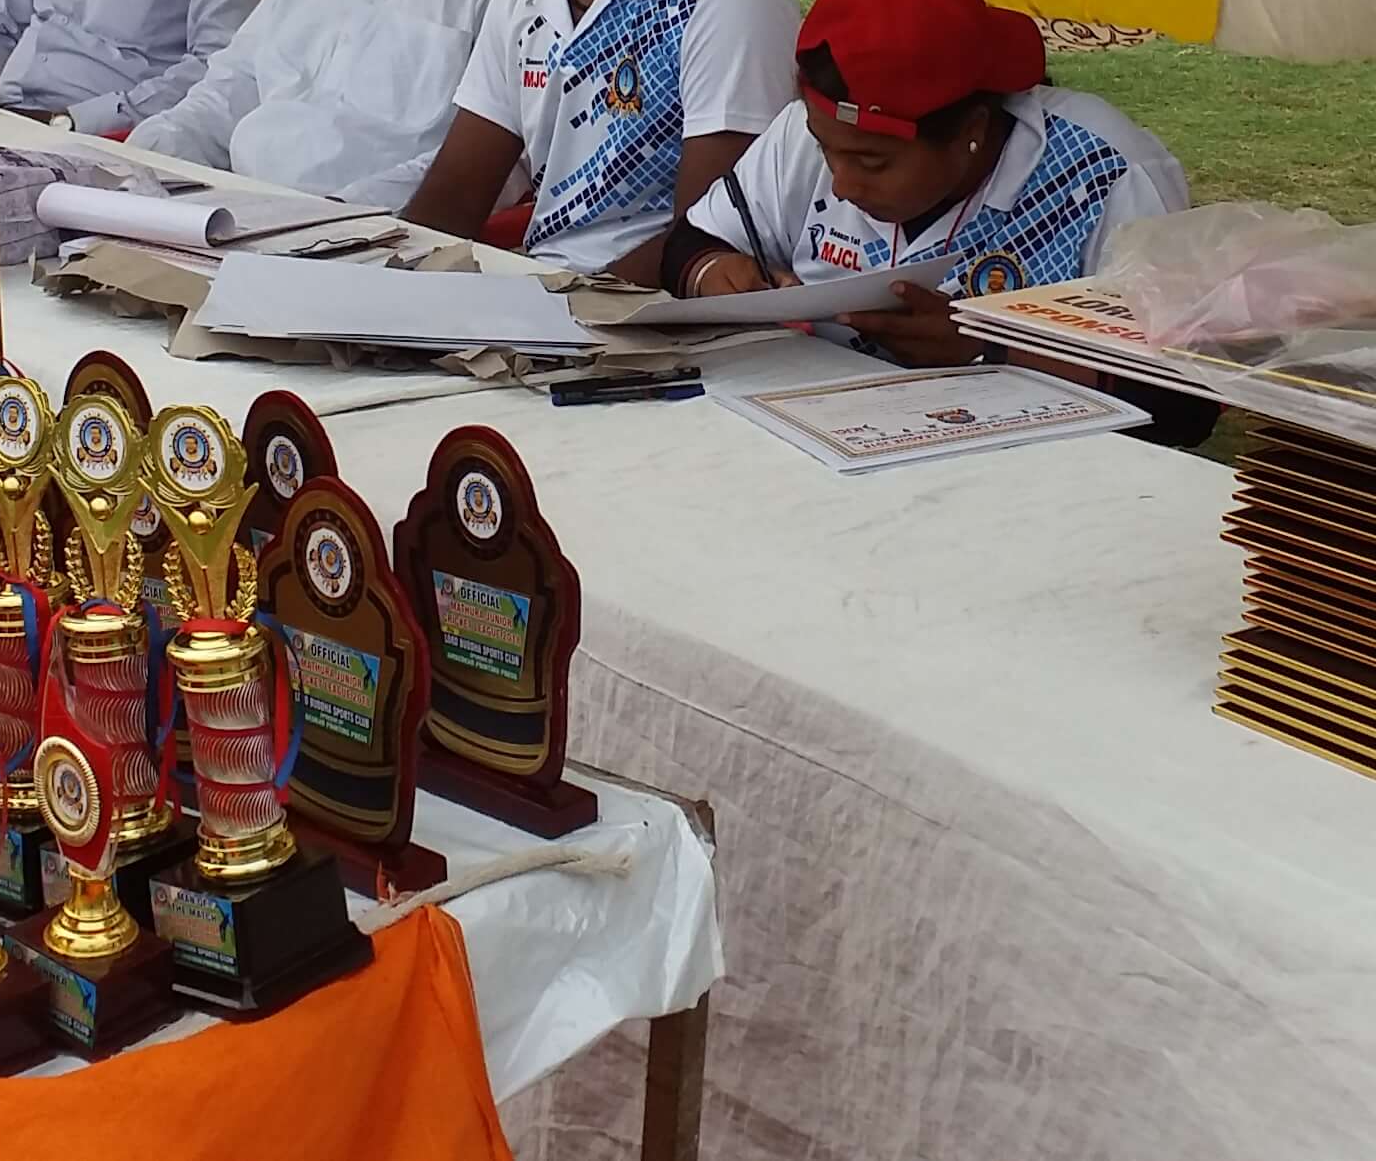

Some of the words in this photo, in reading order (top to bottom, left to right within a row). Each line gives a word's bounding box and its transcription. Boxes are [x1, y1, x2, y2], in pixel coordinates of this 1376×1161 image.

[524, 70, 546, 88] MJC
[821, 241, 862, 272] MJCL
[1006, 303, 1149, 344] SPONSO
[460, 587, 500, 609] OFFICIAL
[451, 601, 481, 618] MATHURA
[487, 613, 513, 628] JUNIOR
[311, 643, 351, 669] OFFICIAL
[482, 646, 504, 660] SPORTS
[505, 653, 520, 666] CLUB
[300, 659, 333, 677] MATHURA
[336, 672, 362, 688] JUNIOR
[333, 706, 355, 721] SPORTS
[355, 715, 370, 728] CLUB
[189, 908, 218, 922] MATCH
